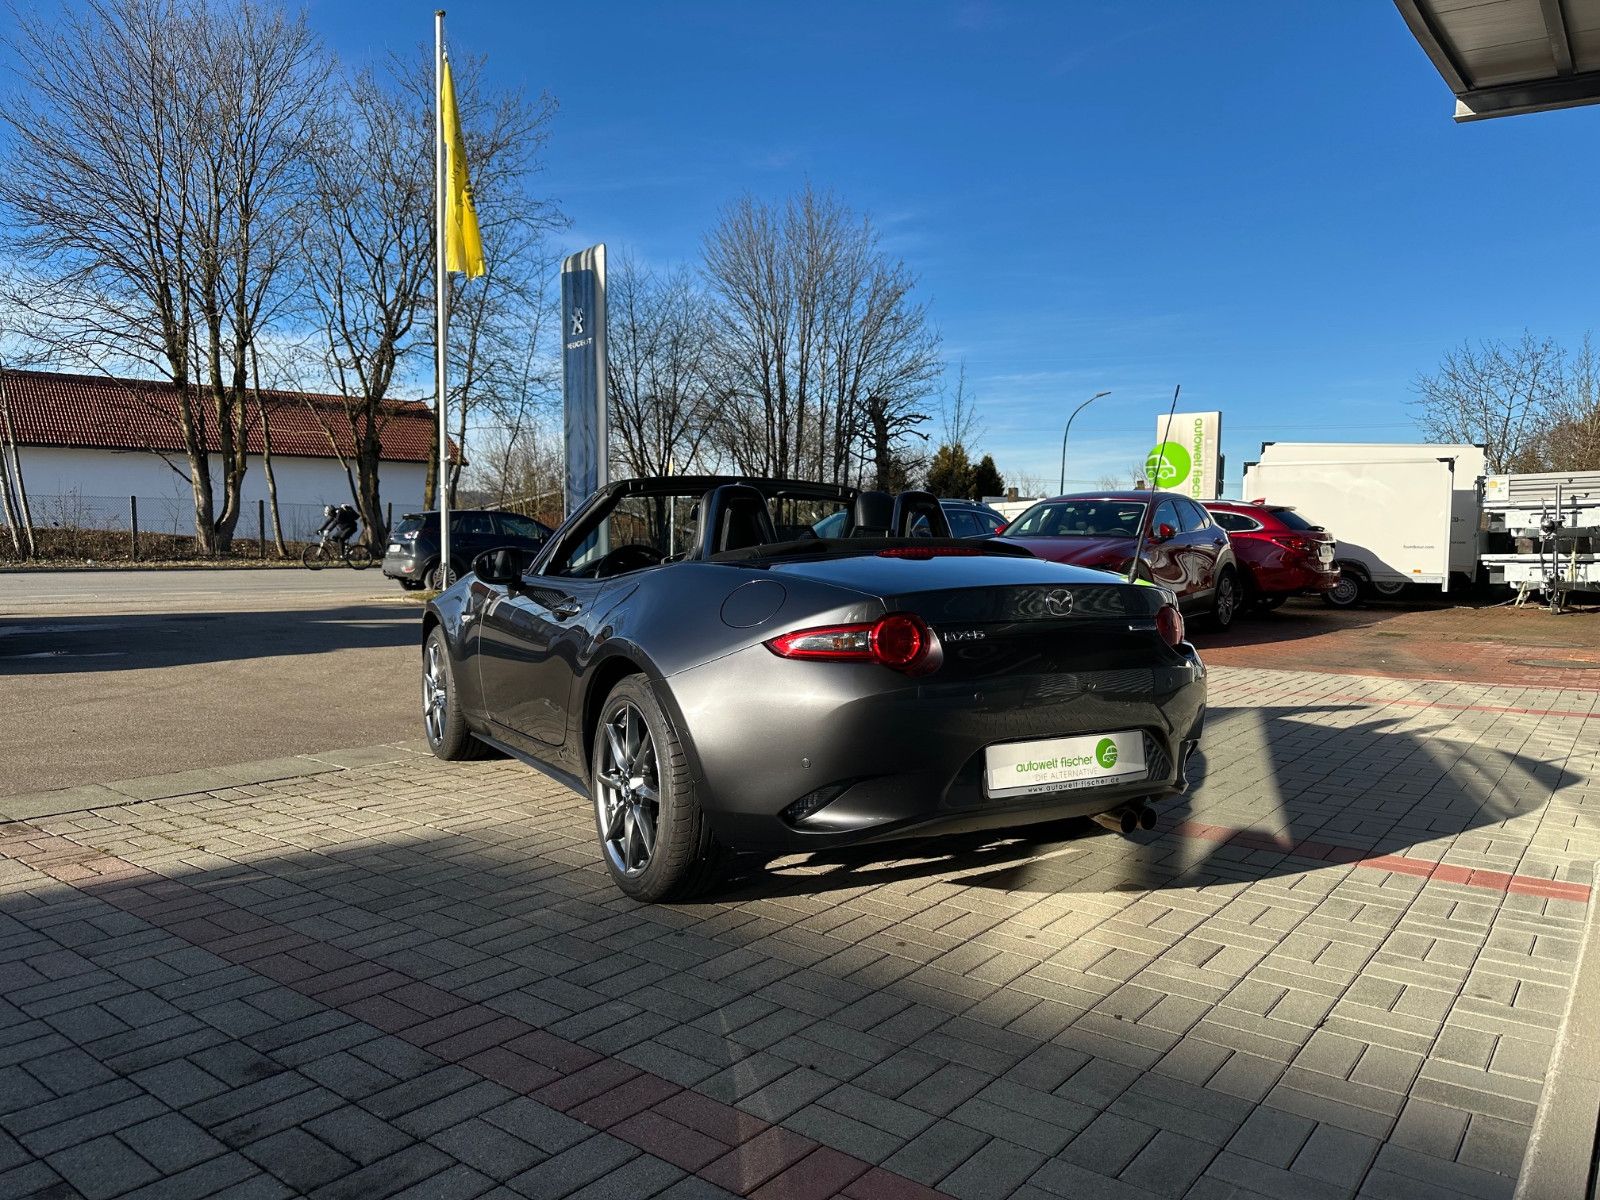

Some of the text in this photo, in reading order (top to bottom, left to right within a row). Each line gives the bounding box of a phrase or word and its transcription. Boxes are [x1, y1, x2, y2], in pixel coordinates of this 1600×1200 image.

[1194, 418, 1205, 467] autowelt
[1016, 754, 1093, 773] autowelt fischer
[1034, 767, 1099, 782] DIE ALTERNATIVE
[1028, 776, 1120, 793] www.autowelt-fischer.de
